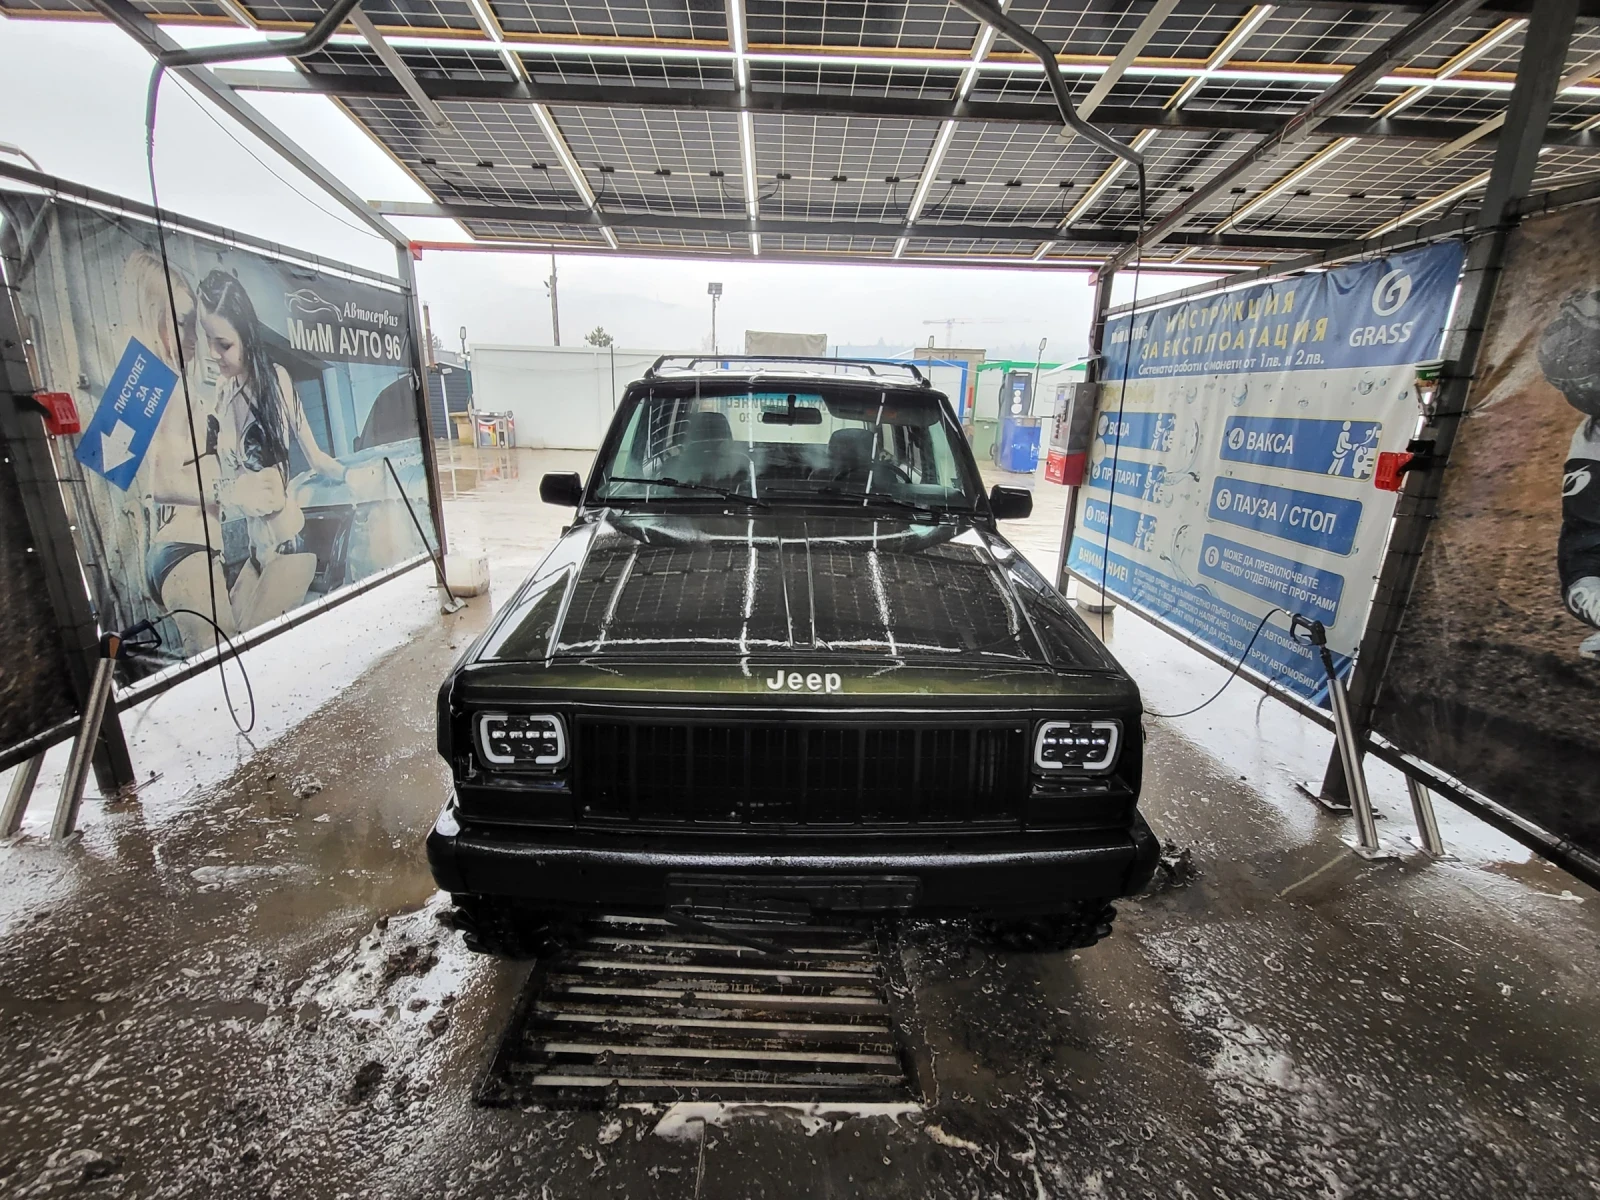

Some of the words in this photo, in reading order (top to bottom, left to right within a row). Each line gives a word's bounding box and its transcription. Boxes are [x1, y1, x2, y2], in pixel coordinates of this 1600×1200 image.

[344, 302, 398, 328] Автосервиз
[1166, 290, 1295, 333] ИНСТРУКЦИЯ
[340, 327, 381, 358] АУТО
[385, 334, 400, 360] 96
[1142, 341, 1158, 360] ЗА
[1162, 317, 1328, 357] ЕКСПЛОАТАЦИЯ
[1349, 322, 1413, 347] GRASS
[1244, 359, 1256, 369] от
[114, 354, 147, 414] ПИСТОЛЕТ
[136, 386, 149, 402] ЗА
[144, 387, 164, 418] ПЯНА
[1246, 432, 1293, 454] ВАКСА
[1102, 467, 1142, 487] ПРПАРАТ
[1233, 494, 1277, 520] ПАУЗА
[1289, 506, 1336, 534] СТОП
[1223, 548, 1243, 562] МОЖЕ
[1244, 555, 1253, 567] ДА
[1255, 559, 1319, 589] ПРЕВКЛЮЧВАТЕ
[1221, 561, 1243, 577] МЕЖДУ
[1244, 569, 1287, 594] ОТДЕЛНИТЕ
[1288, 586, 1336, 612] ПРОГРАМИ
[1208, 625, 1217, 636] ДА
[1218, 631, 1246, 651] ИЗСЪХВА
[1269, 658, 1319, 691] АВТОМОБИЛА
[1264, 629, 1313, 660] АВТОМОБИЛА
[767, 670, 841, 692] Jeep
